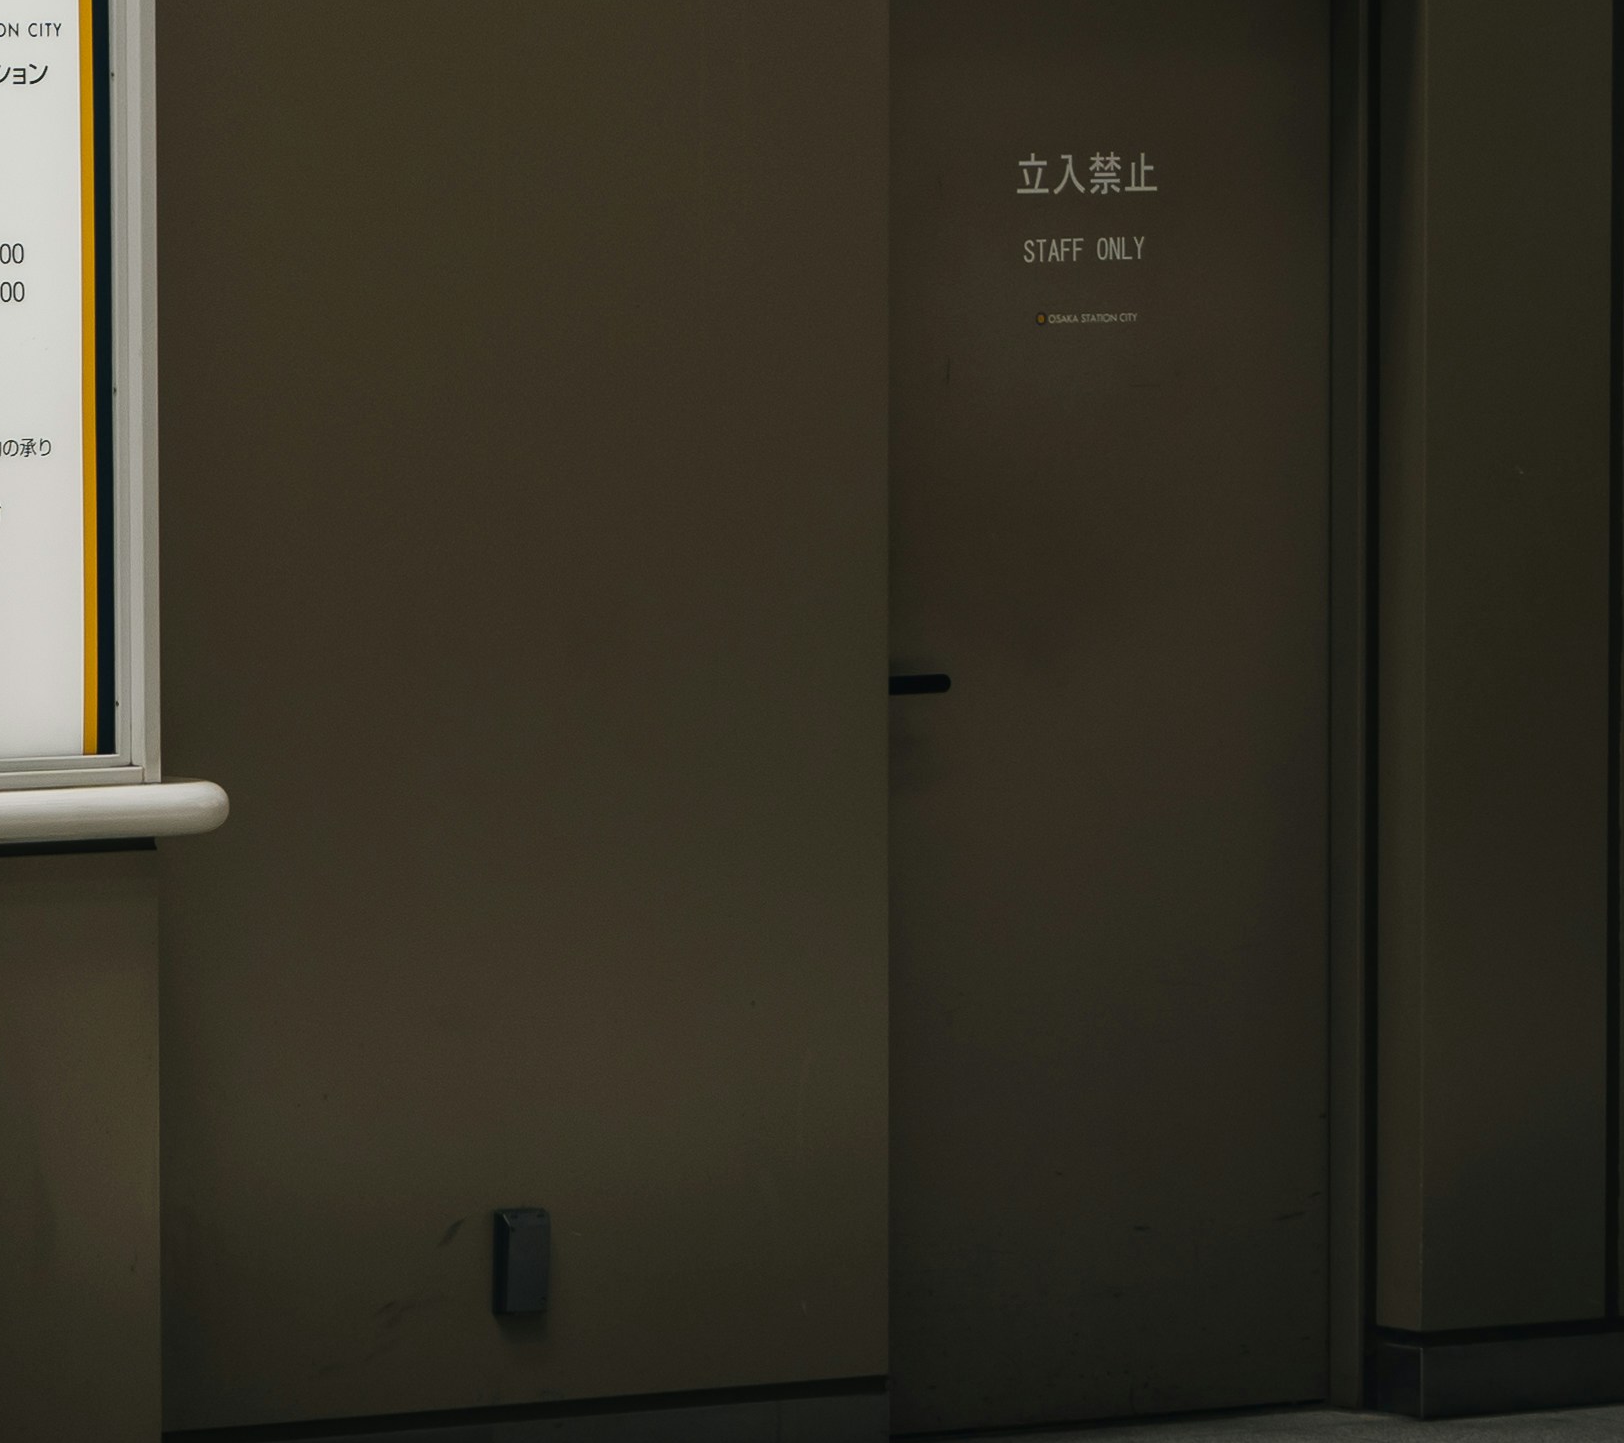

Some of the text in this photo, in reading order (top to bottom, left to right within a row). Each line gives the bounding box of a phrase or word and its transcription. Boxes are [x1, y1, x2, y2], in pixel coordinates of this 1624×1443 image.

[28, 22, 62, 37] CITY
[1016, 152, 1158, 195] 立入禁止
[1023, 236, 1146, 263] STAFF ONLY
[1048, 312, 1138, 324] OSAKA STATION CITY
